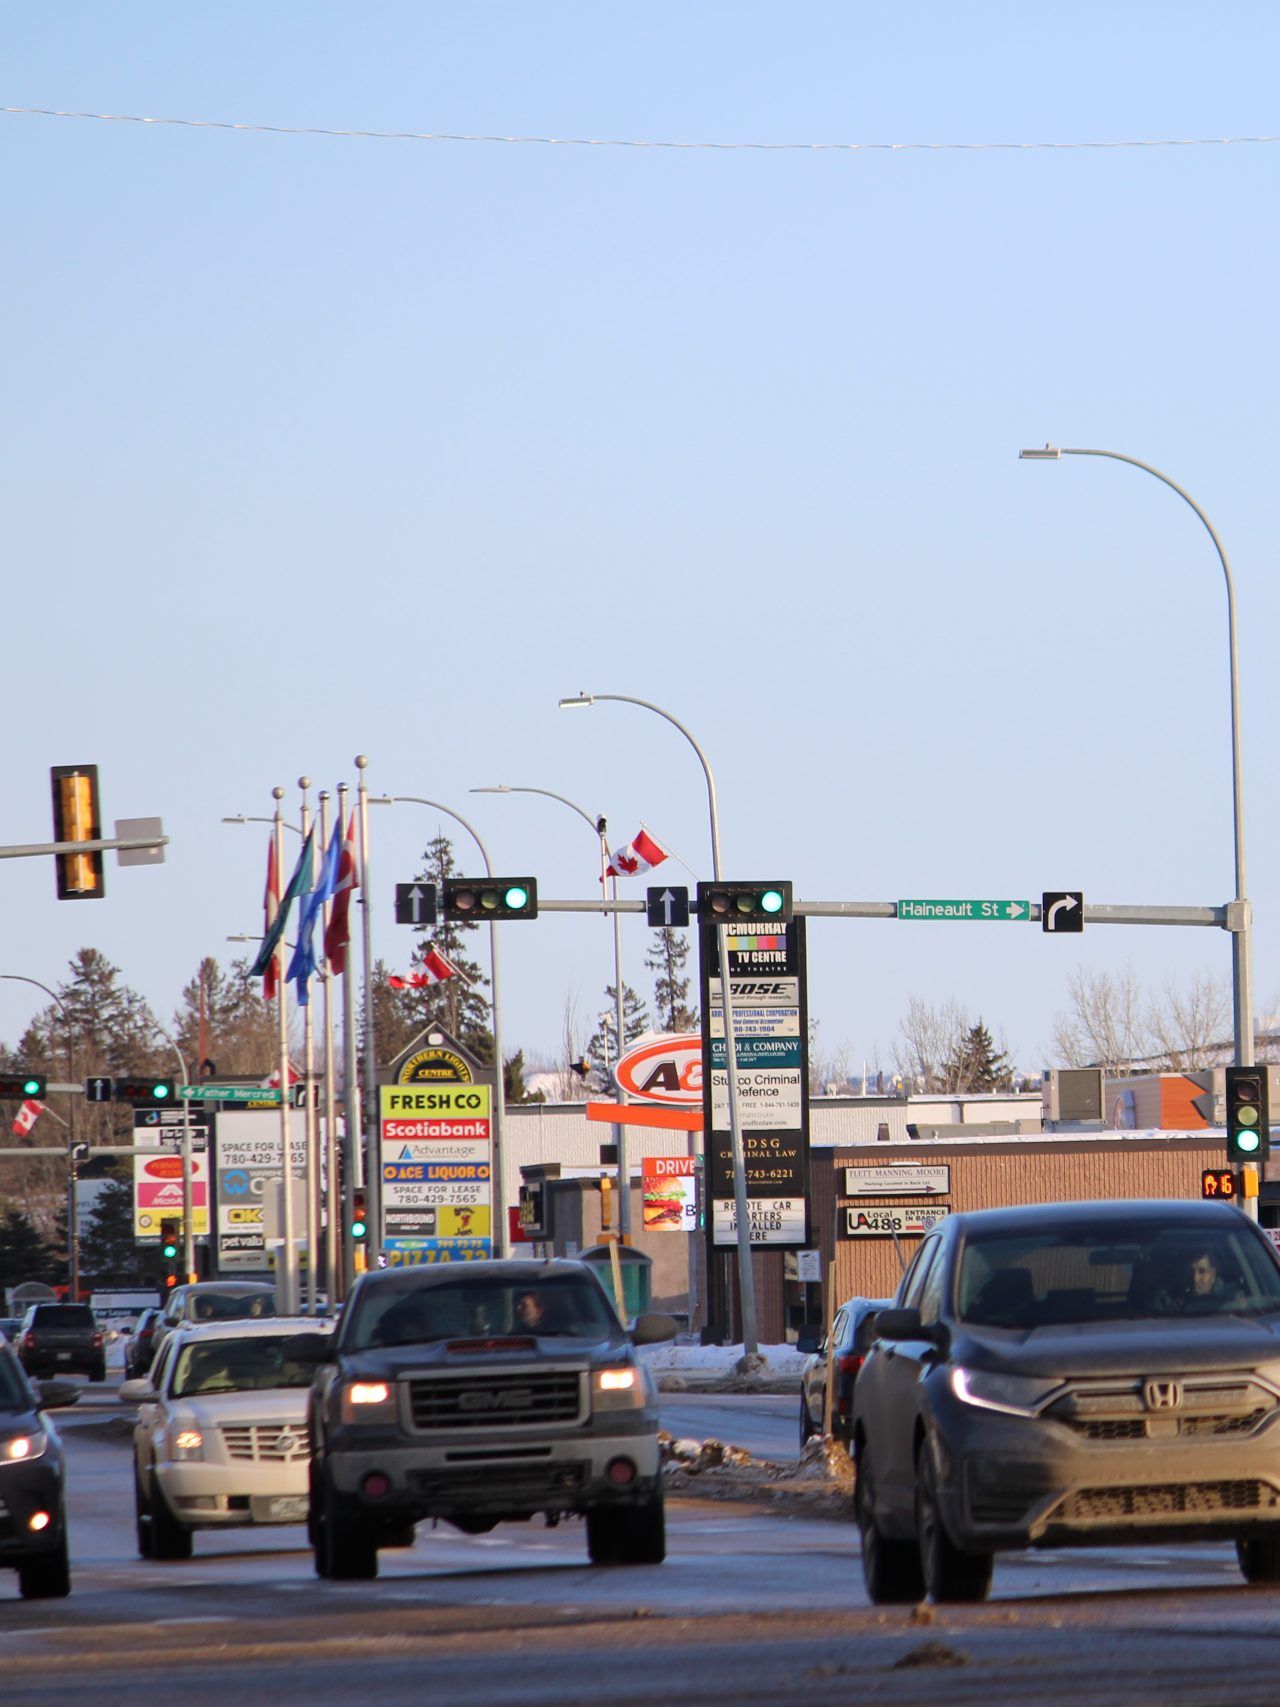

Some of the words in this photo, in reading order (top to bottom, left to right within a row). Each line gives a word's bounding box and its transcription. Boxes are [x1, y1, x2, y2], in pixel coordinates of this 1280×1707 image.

[902, 902, 972, 916] Haineault
[981, 902, 999, 916] St
[726, 922, 787, 935] CMURRAY
[737, 951, 750, 963] TV
[751, 951, 787, 963] CENTRE
[732, 1009, 765, 1017] PROFESSIONAL
[765, 1009, 798, 1017] CORPORATION
[733, 1025, 775, 1033] 80-743-1904
[752, 1042, 799, 1052] COMPANY
[402, 1050, 443, 1084] NORTHERN
[444, 1053, 470, 1083] LIGHTS
[418, 1069, 454, 1077] CENTRE
[712, 1074, 752, 1086] Stuco
[754, 1074, 800, 1086] Criminal
[385, 1122, 486, 1137] Scotiabank
[221, 1142, 253, 1152] SPACE
[254, 1142, 275, 1151] FOR
[277, 1141, 308, 1151] LASE
[748, 1138, 780, 1149] DSG
[413, 1144, 476, 1158] Advantage
[224, 1152, 305, 1164] 780-429-765
[398, 1166, 424, 1179] ACE
[428, 1165, 476, 1181] LIQUOR
[849, 1169, 872, 1177] FLETT
[875, 1168, 913, 1177] MANNING
[916, 1168, 945, 1176] MOORE
[393, 1186, 423, 1194] SPACE
[452, 1185, 481, 1193] LEASE
[1219, 1174, 1233, 1194] 16
[398, 1194, 477, 1203] 780-429-7565
[724, 1201, 762, 1211] REOTE
[773, 1201, 792, 1210] CAR
[867, 1210, 893, 1219] Local
[868, 1217, 903, 1231] 488
[749, 1231, 767, 1241] ERE
[389, 1249, 452, 1267] PIZZA
